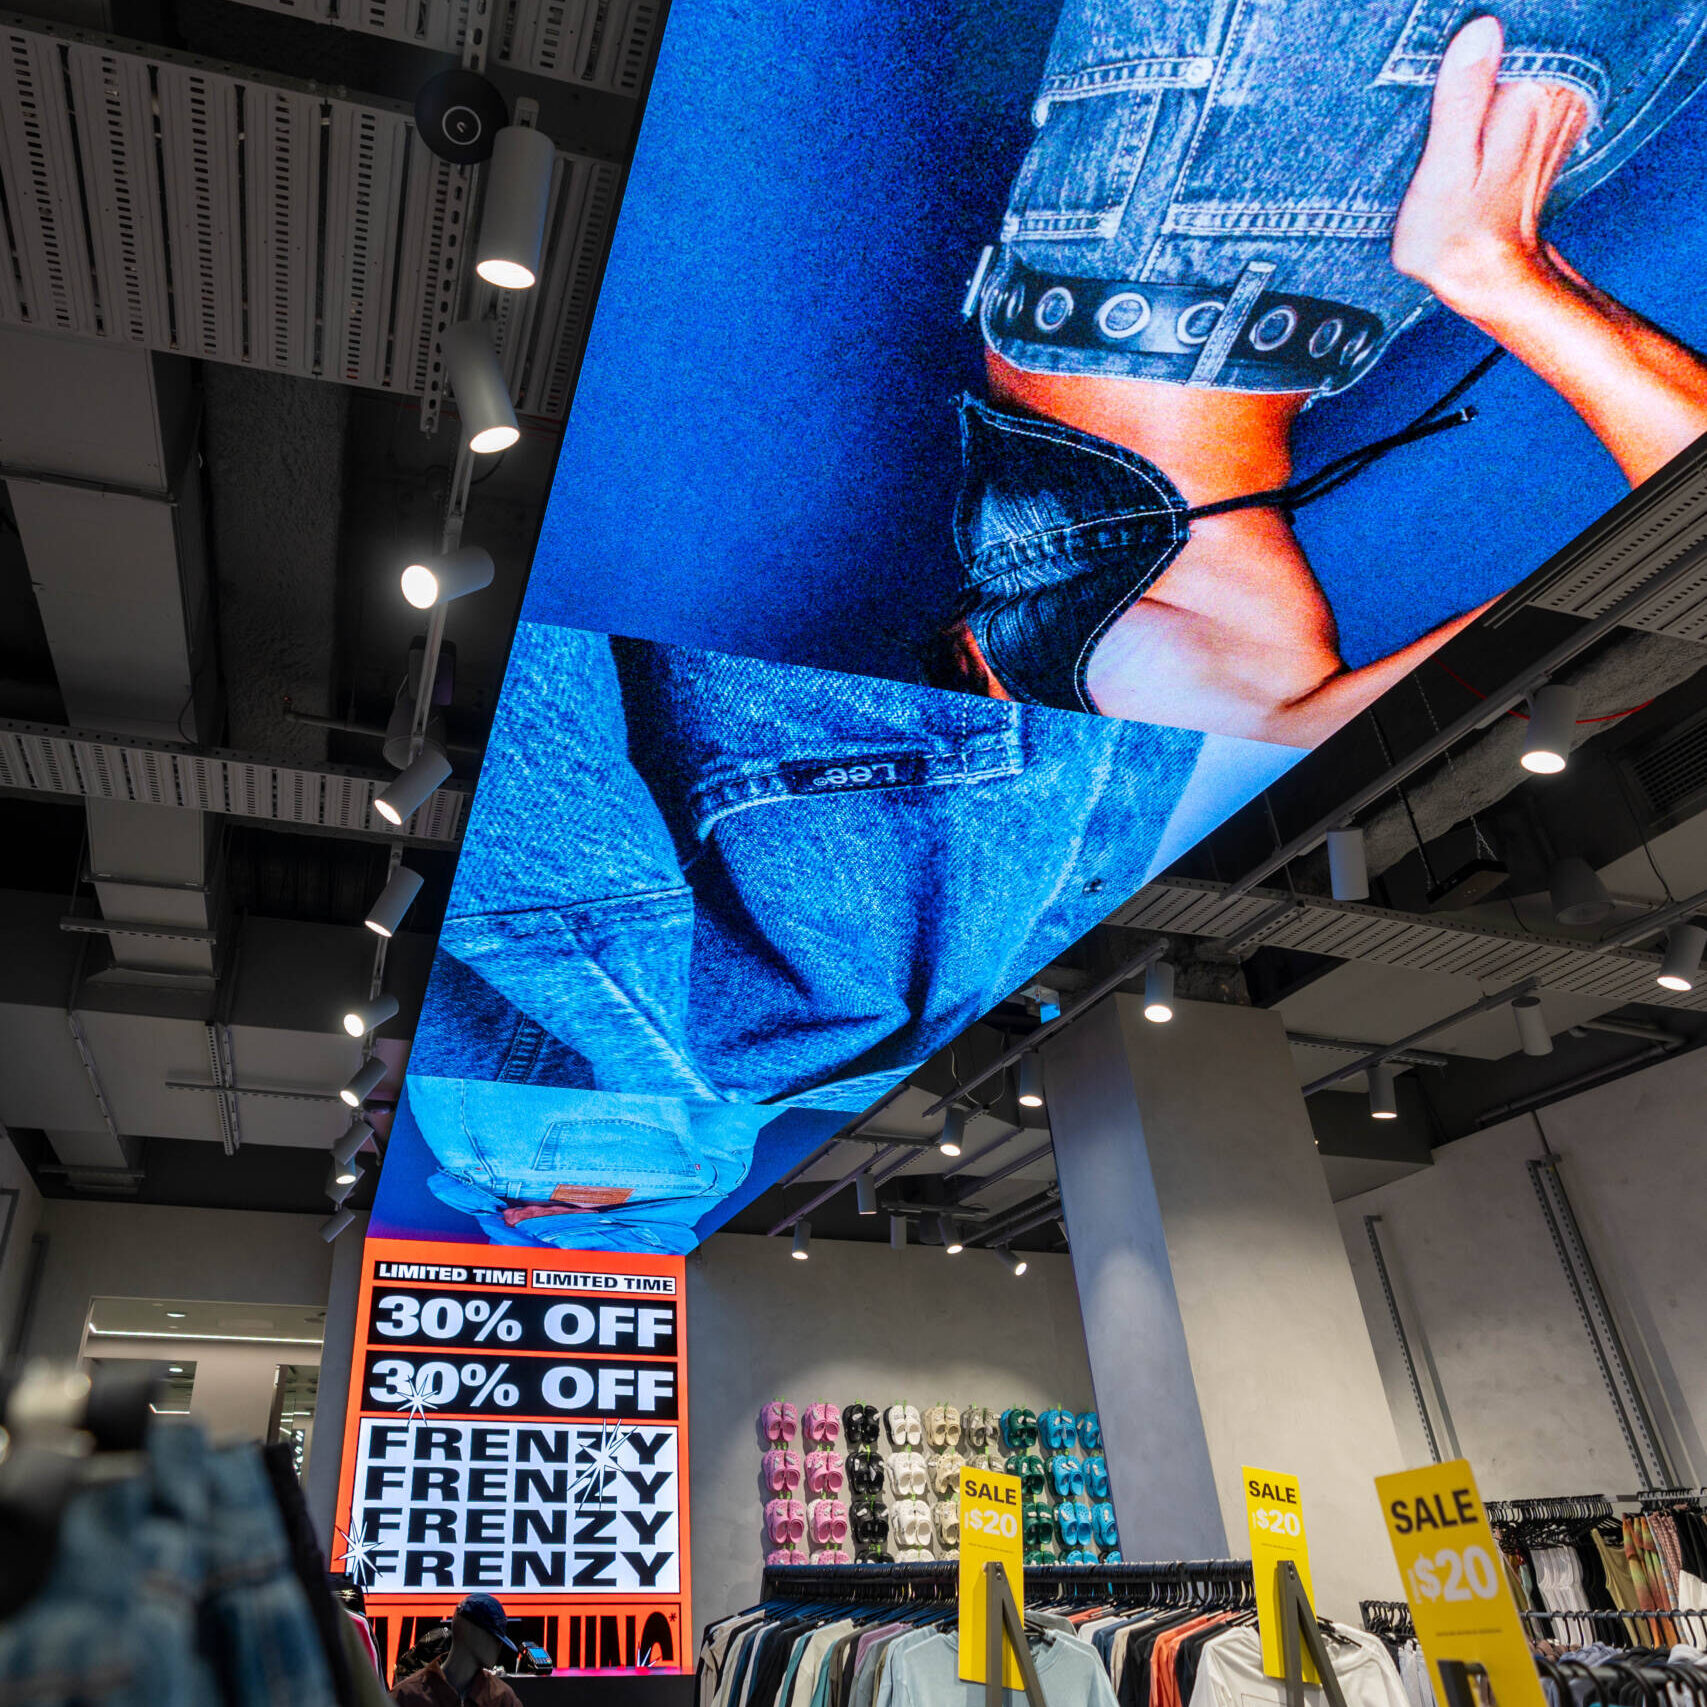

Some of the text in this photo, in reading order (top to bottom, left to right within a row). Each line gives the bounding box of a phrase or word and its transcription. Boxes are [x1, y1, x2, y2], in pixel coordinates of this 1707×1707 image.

[379, 1263, 526, 1285] LIMITED TIME
[535, 1272, 674, 1292] LIMITED TIME
[375, 1295, 673, 1348] 30% OFF
[369, 1359, 674, 1411] 30% OFF
[368, 1425, 673, 1465] FRENZY
[364, 1466, 674, 1505] FRENZY
[965, 1480, 1017, 1505] SALE
[1248, 1480, 1297, 1504] SALE
[362, 1507, 674, 1545] FRENZY
[969, 1507, 1018, 1538] $20
[1256, 1508, 1300, 1537] $20
[1391, 1488, 1479, 1535] SALE
[357, 1550, 674, 1588] FRENZY
[1414, 1544, 1499, 1604] $20
